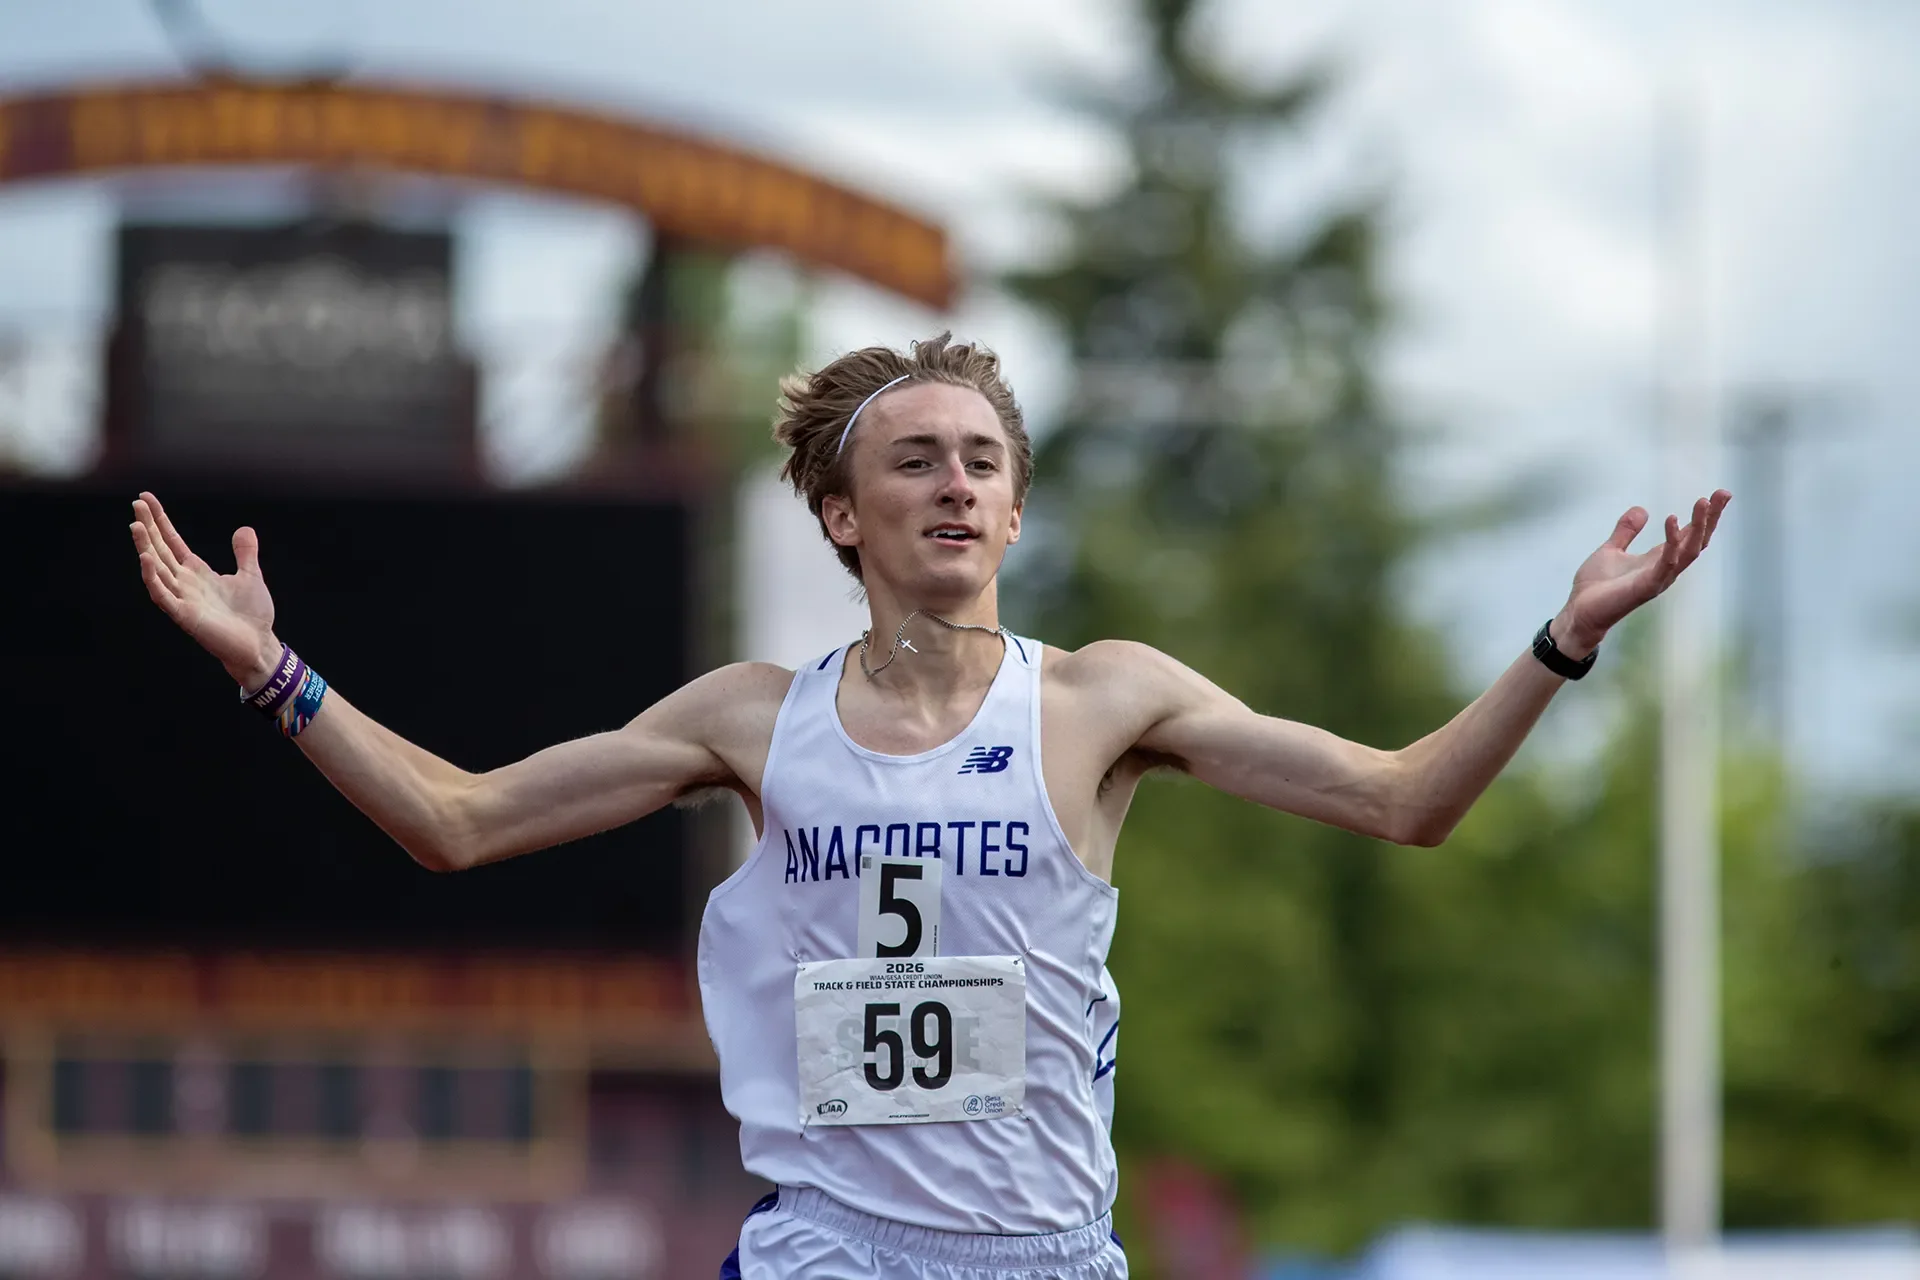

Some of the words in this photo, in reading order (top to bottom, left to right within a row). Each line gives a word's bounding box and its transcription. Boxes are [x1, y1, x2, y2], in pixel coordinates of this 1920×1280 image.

[276, 652, 299, 690] WON'T
[254, 686, 281, 708] WIN
[784, 821, 1030, 884] ANACORTES
[875, 863, 924, 958] 5
[813, 982, 844, 990] TRACK
[846, 981, 853, 990] &
[855, 981, 882, 990] FIELD
[884, 980, 915, 989] STATE
[918, 978, 1004, 989] CHAMPIONSHIPS
[886, 963, 925, 973] 2026
[863, 1001, 952, 1091] 59
